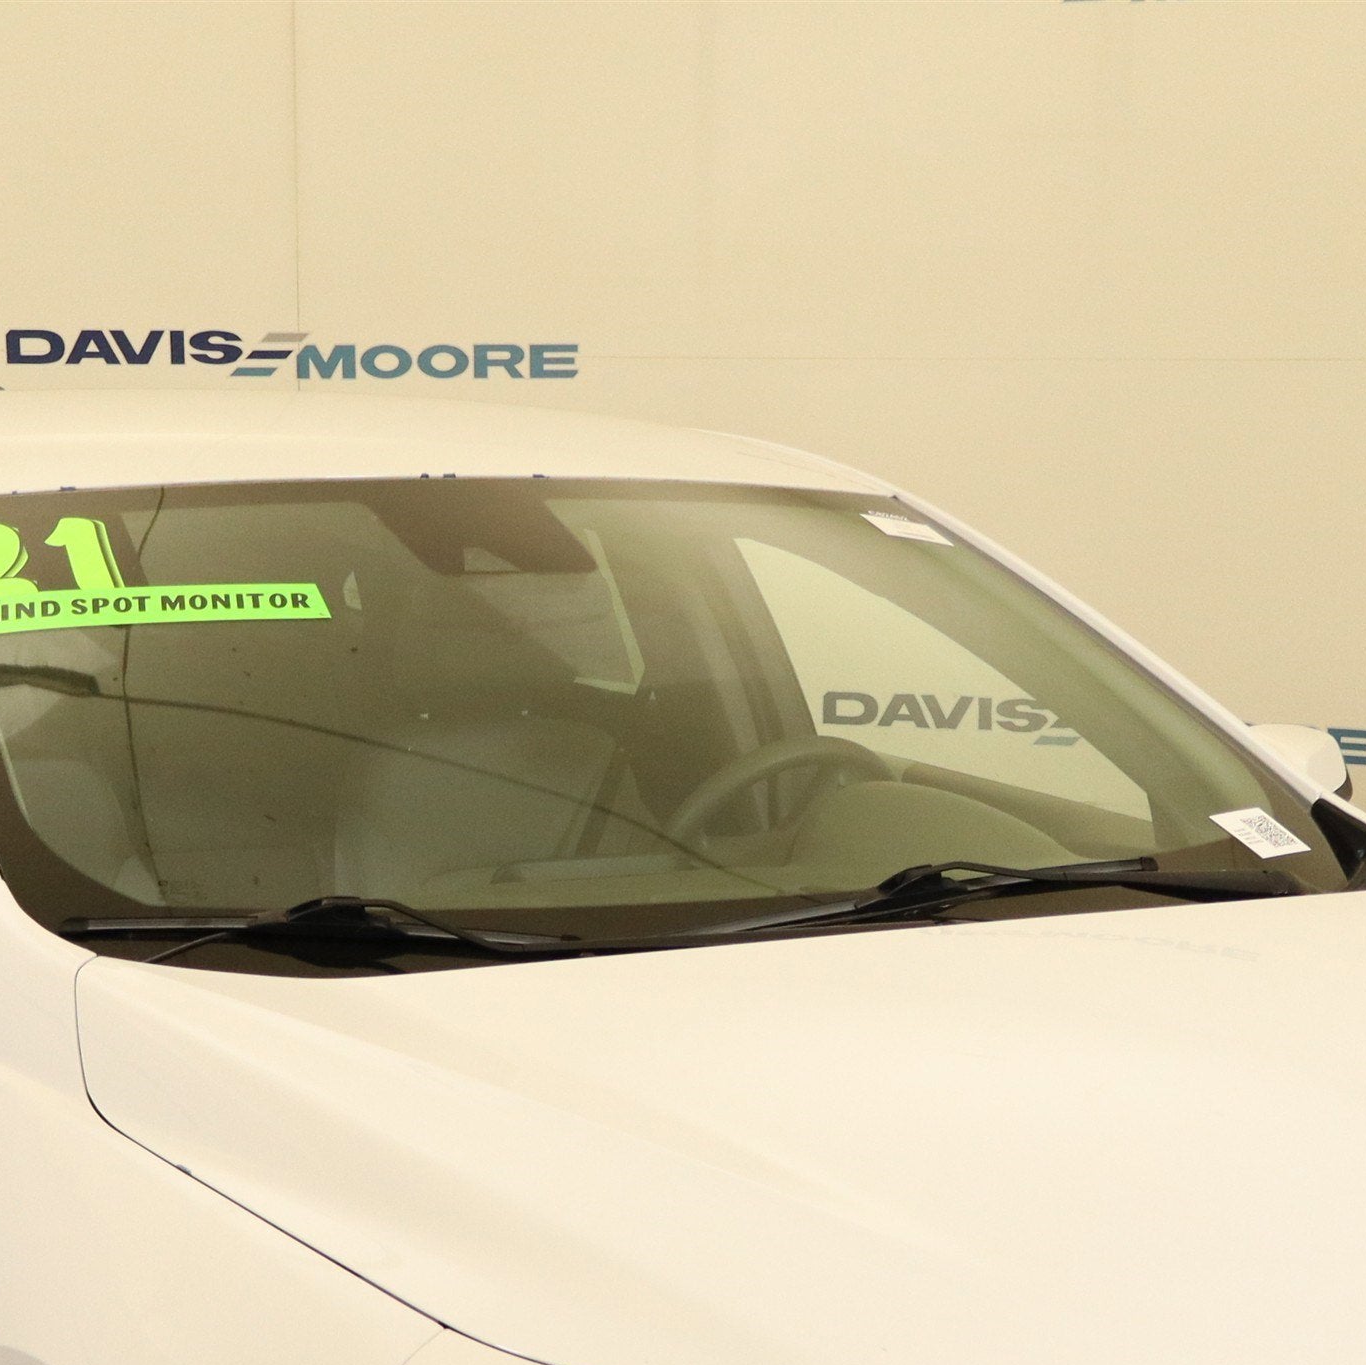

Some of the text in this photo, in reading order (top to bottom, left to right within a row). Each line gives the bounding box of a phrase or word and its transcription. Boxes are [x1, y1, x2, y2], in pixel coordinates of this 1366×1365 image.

[5, 330, 579, 379] DAVIS MOORE
[71, 595, 151, 616] SPOT
[161, 592, 311, 612] MONITOR
[822, 691, 1049, 733] DAVIS
